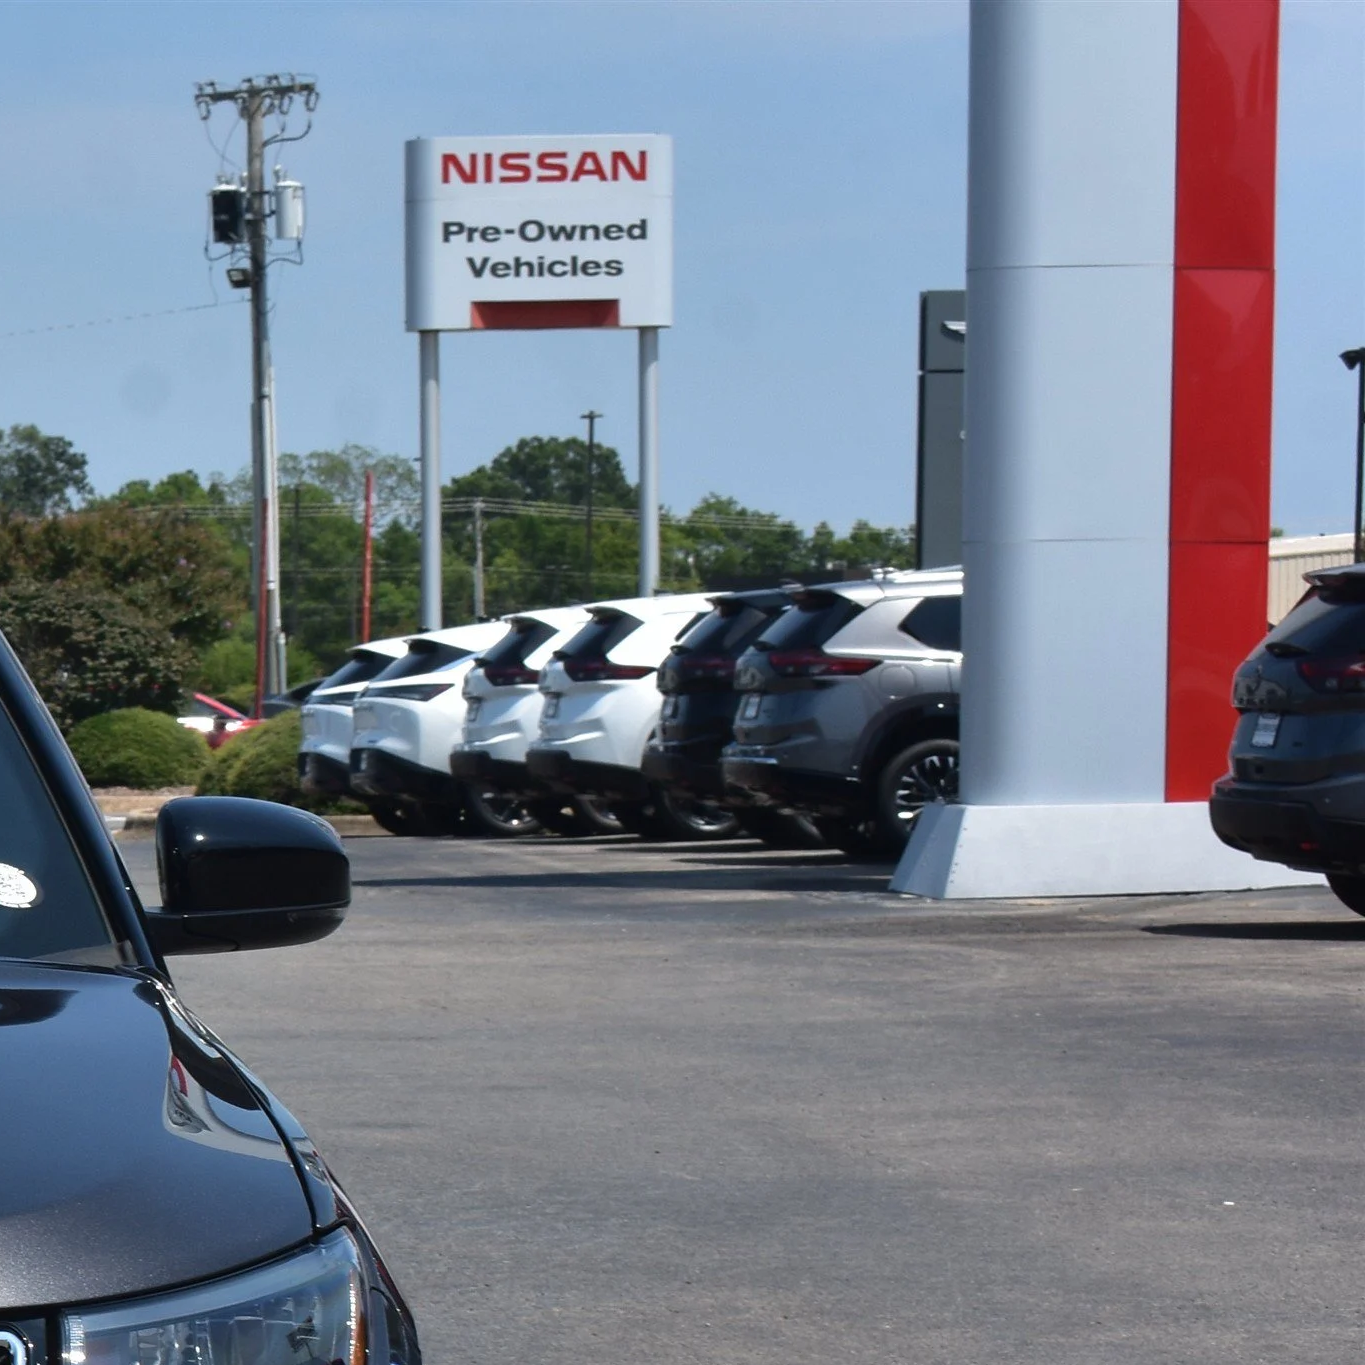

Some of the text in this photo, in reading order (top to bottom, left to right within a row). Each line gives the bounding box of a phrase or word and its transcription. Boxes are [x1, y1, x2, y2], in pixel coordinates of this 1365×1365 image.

[441, 150, 648, 184] NISSAN
[442, 219, 648, 243] Pre-Owned
[466, 256, 624, 278] Vehicles
